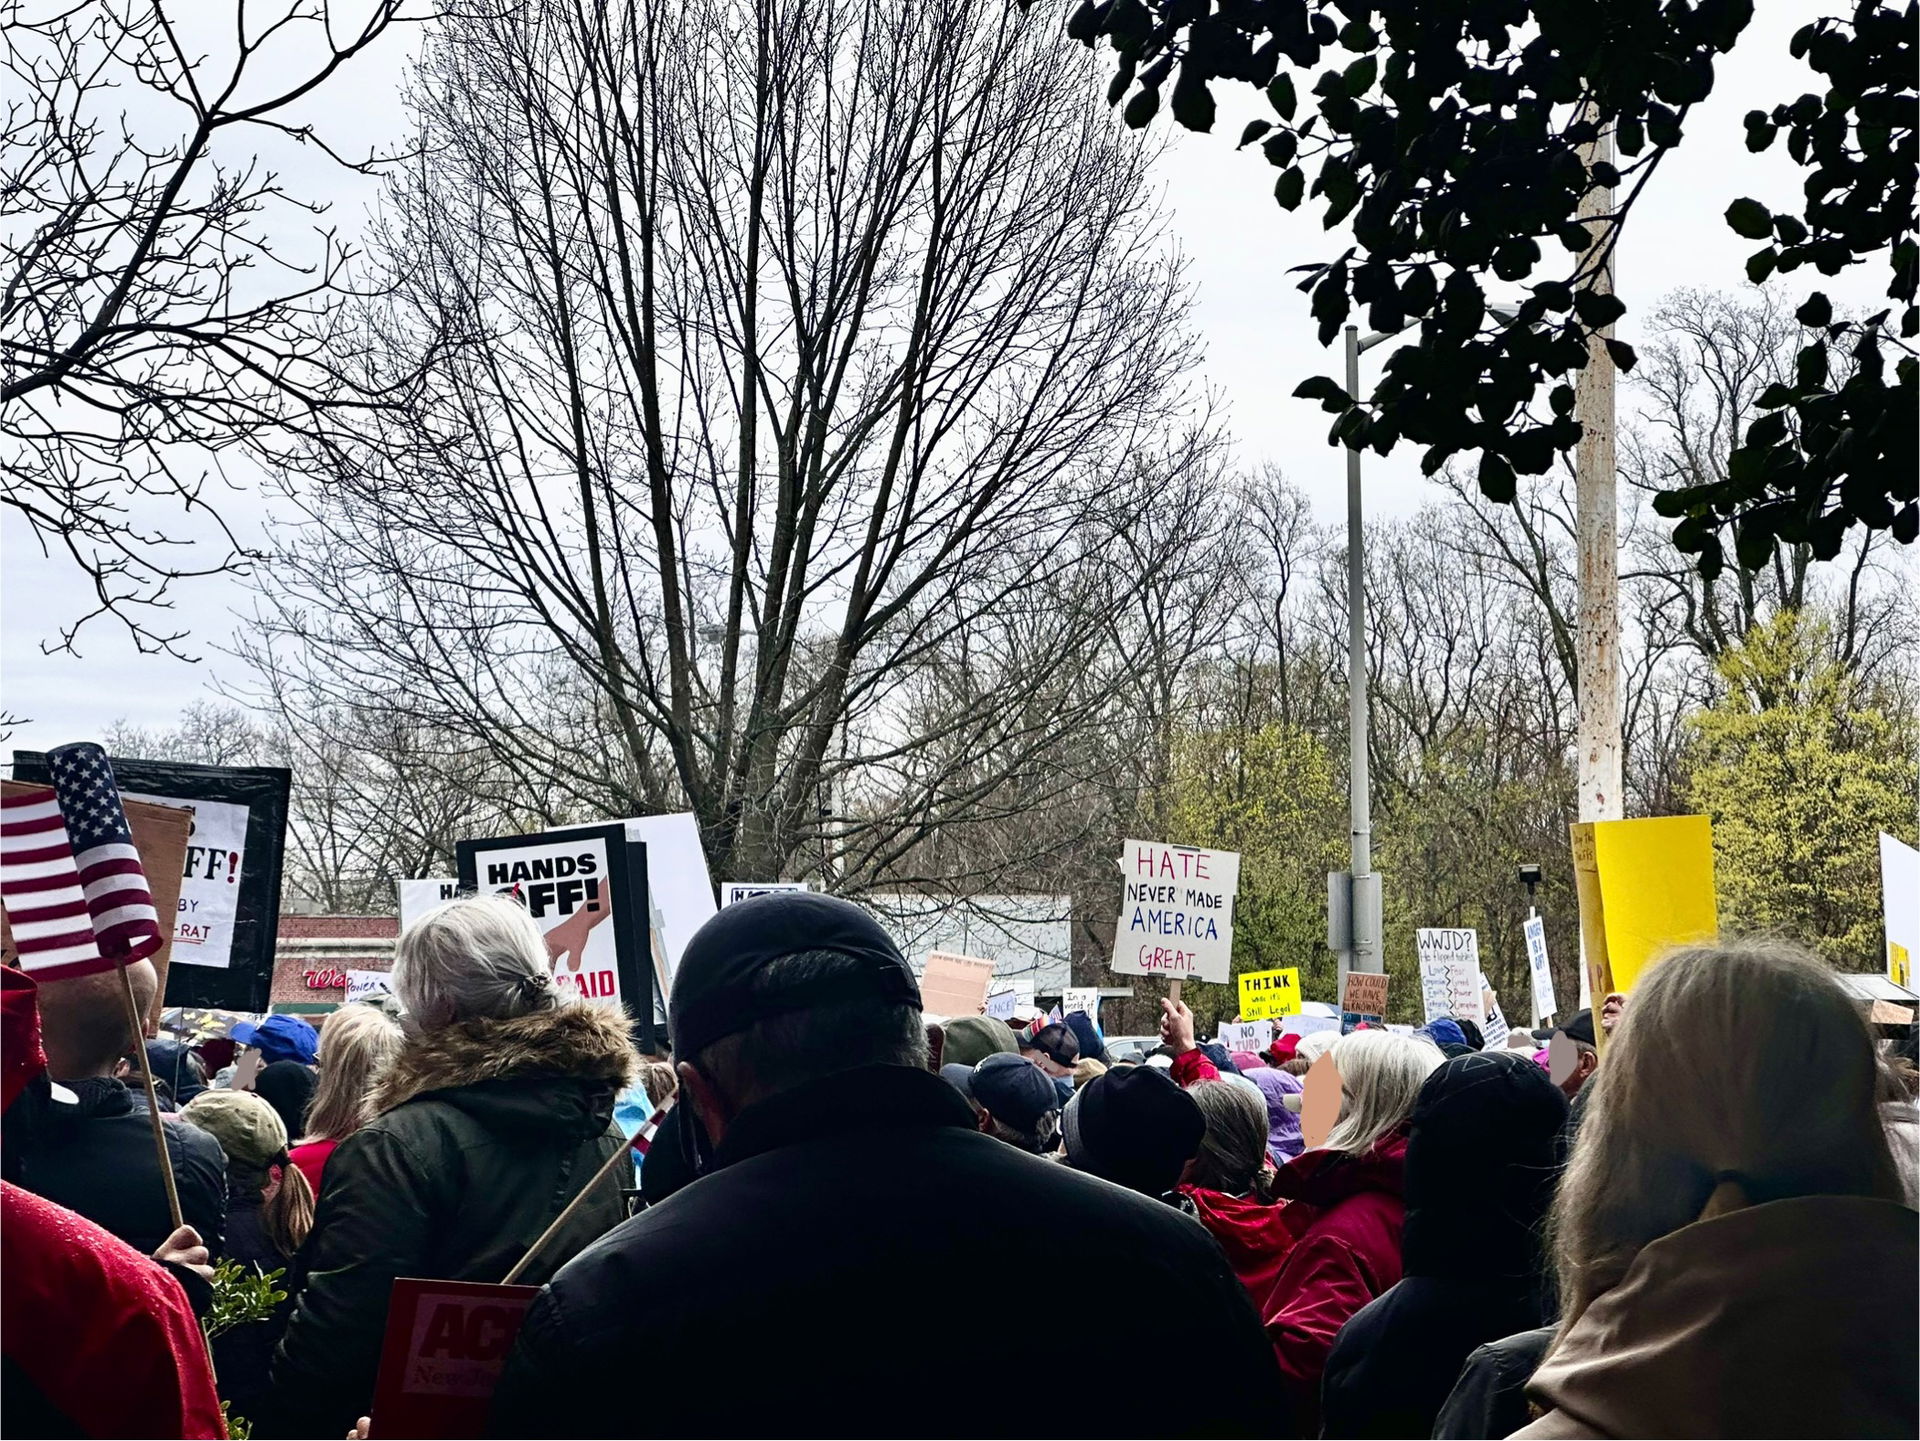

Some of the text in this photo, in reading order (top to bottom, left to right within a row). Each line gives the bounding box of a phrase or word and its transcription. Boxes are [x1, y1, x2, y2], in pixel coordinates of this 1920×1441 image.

[183, 846, 238, 884] FF!
[488, 853, 597, 884] HANDS
[1138, 847, 1210, 880] HATE
[1128, 883, 1222, 909] NEVER MADE
[1131, 906, 1218, 941] AMERICA
[1417, 930, 1472, 952] WWJD?
[1139, 944, 1196, 972] GREAT.
[303, 968, 347, 989] Wa
[556, 970, 615, 999] AID
[1245, 975, 1290, 991] THINK
[1064, 1001, 1084, 1010] world
[1066, 992, 1078, 1001] In
[988, 1001, 1012, 1015] ENCE
[1269, 1003, 1291, 1016] Legal
[1240, 1025, 1255, 1038] NO
